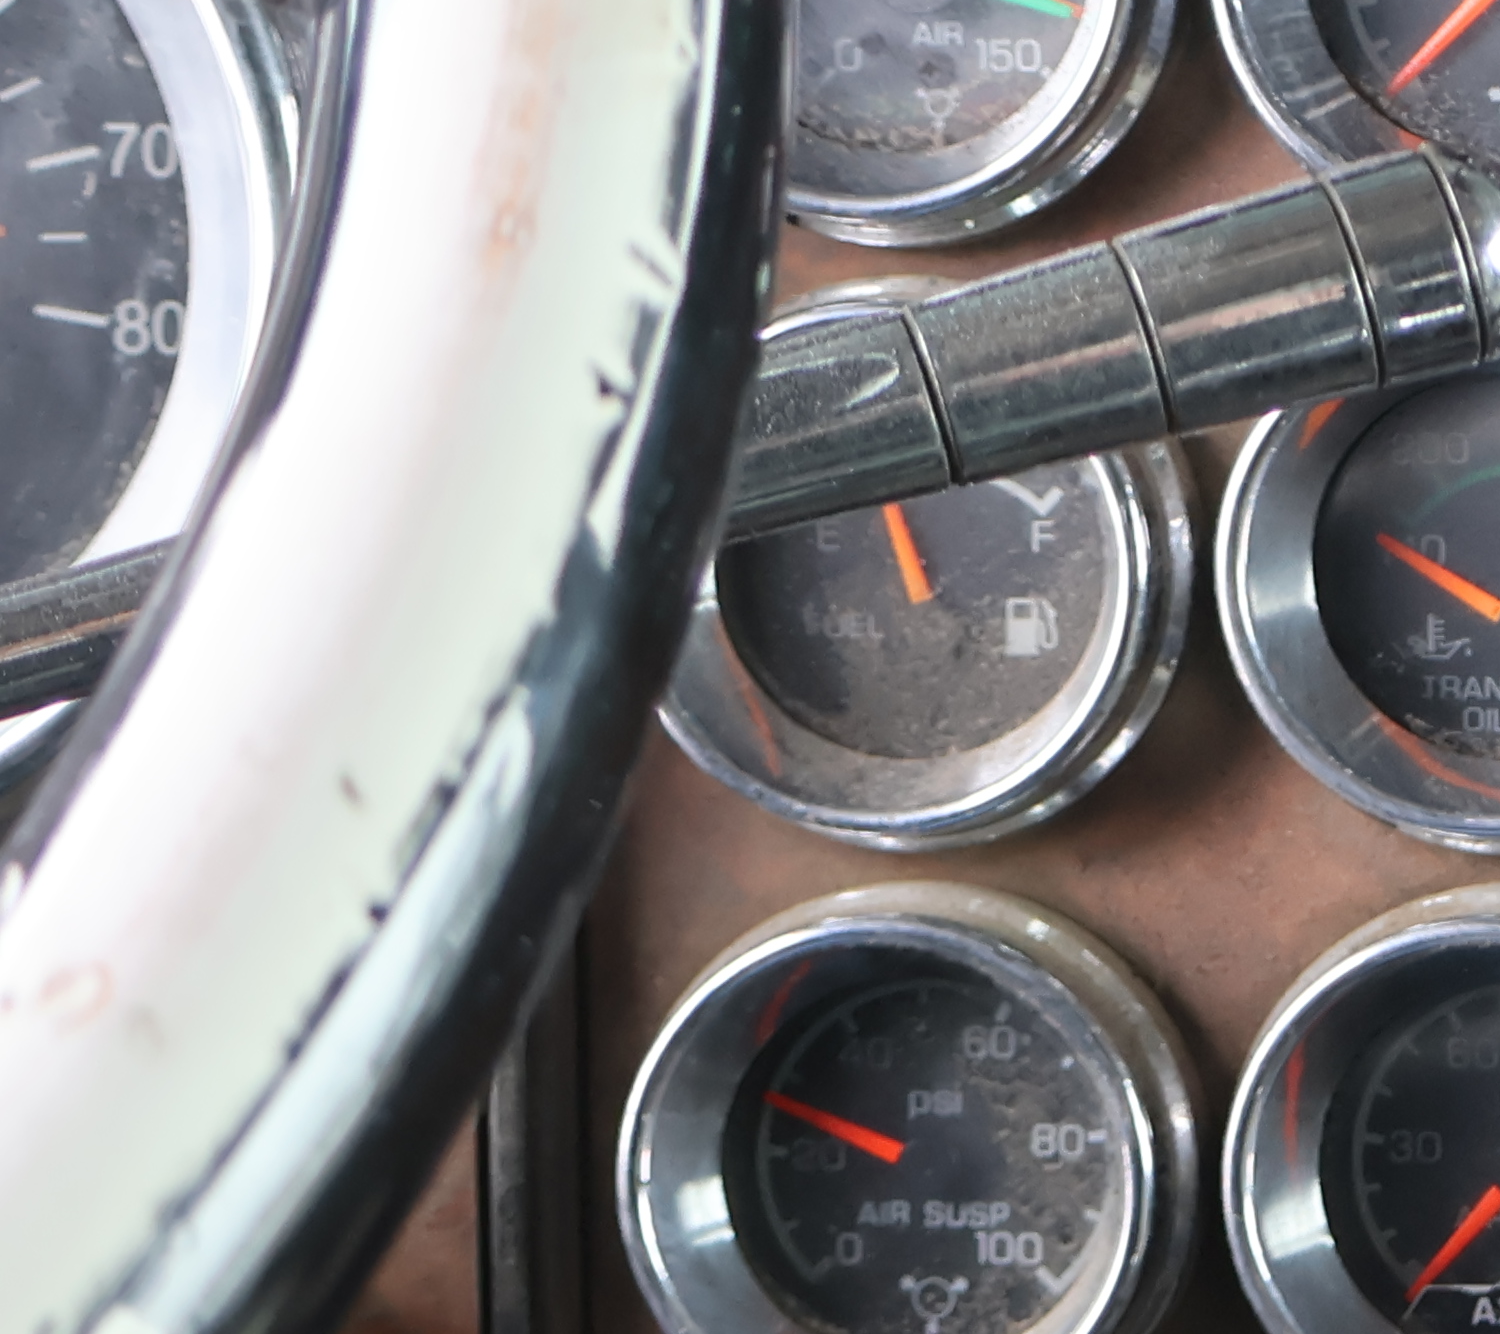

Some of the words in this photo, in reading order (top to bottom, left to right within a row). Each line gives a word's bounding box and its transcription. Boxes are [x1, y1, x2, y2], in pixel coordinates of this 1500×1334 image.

[912, 21, 965, 47] AIR
[975, 38, 1042, 73] 150
[103, 121, 178, 181] 70
[111, 298, 185, 357] 80
[1461, 706, 1500, 733] OIL
[961, 1025, 1016, 1060] 60
[1029, 1122, 1085, 1157] 80
[857, 1200, 911, 1225] AIR
[922, 1200, 1012, 1228] SUSP
[974, 1231, 1044, 1267] 100
